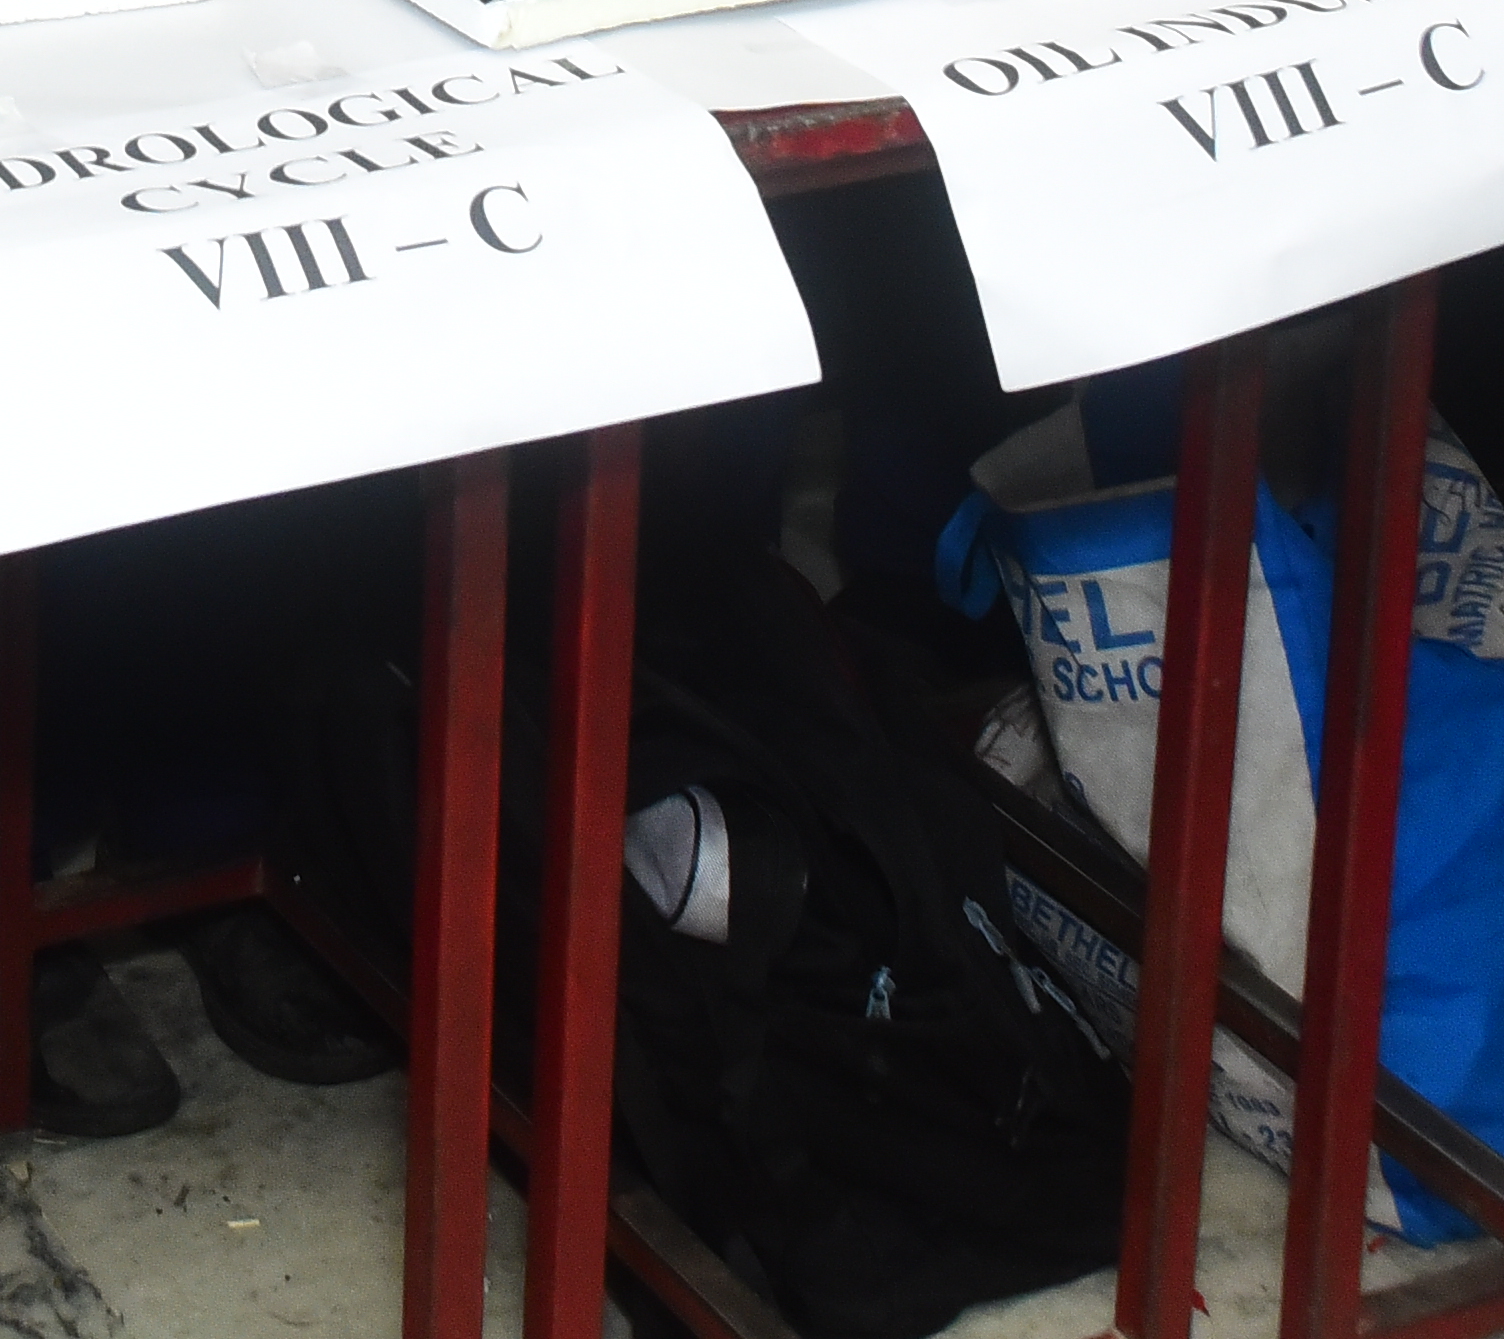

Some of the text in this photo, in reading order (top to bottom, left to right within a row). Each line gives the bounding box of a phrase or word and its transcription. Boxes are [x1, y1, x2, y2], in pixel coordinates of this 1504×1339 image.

[943, 40, 1123, 98] OIL
[1158, 19, 1486, 163] VIII C
[120, 129, 485, 215] CYCLE
[158, 182, 544, 311] VIII C
[1053, 655, 1165, 703] SCHO
